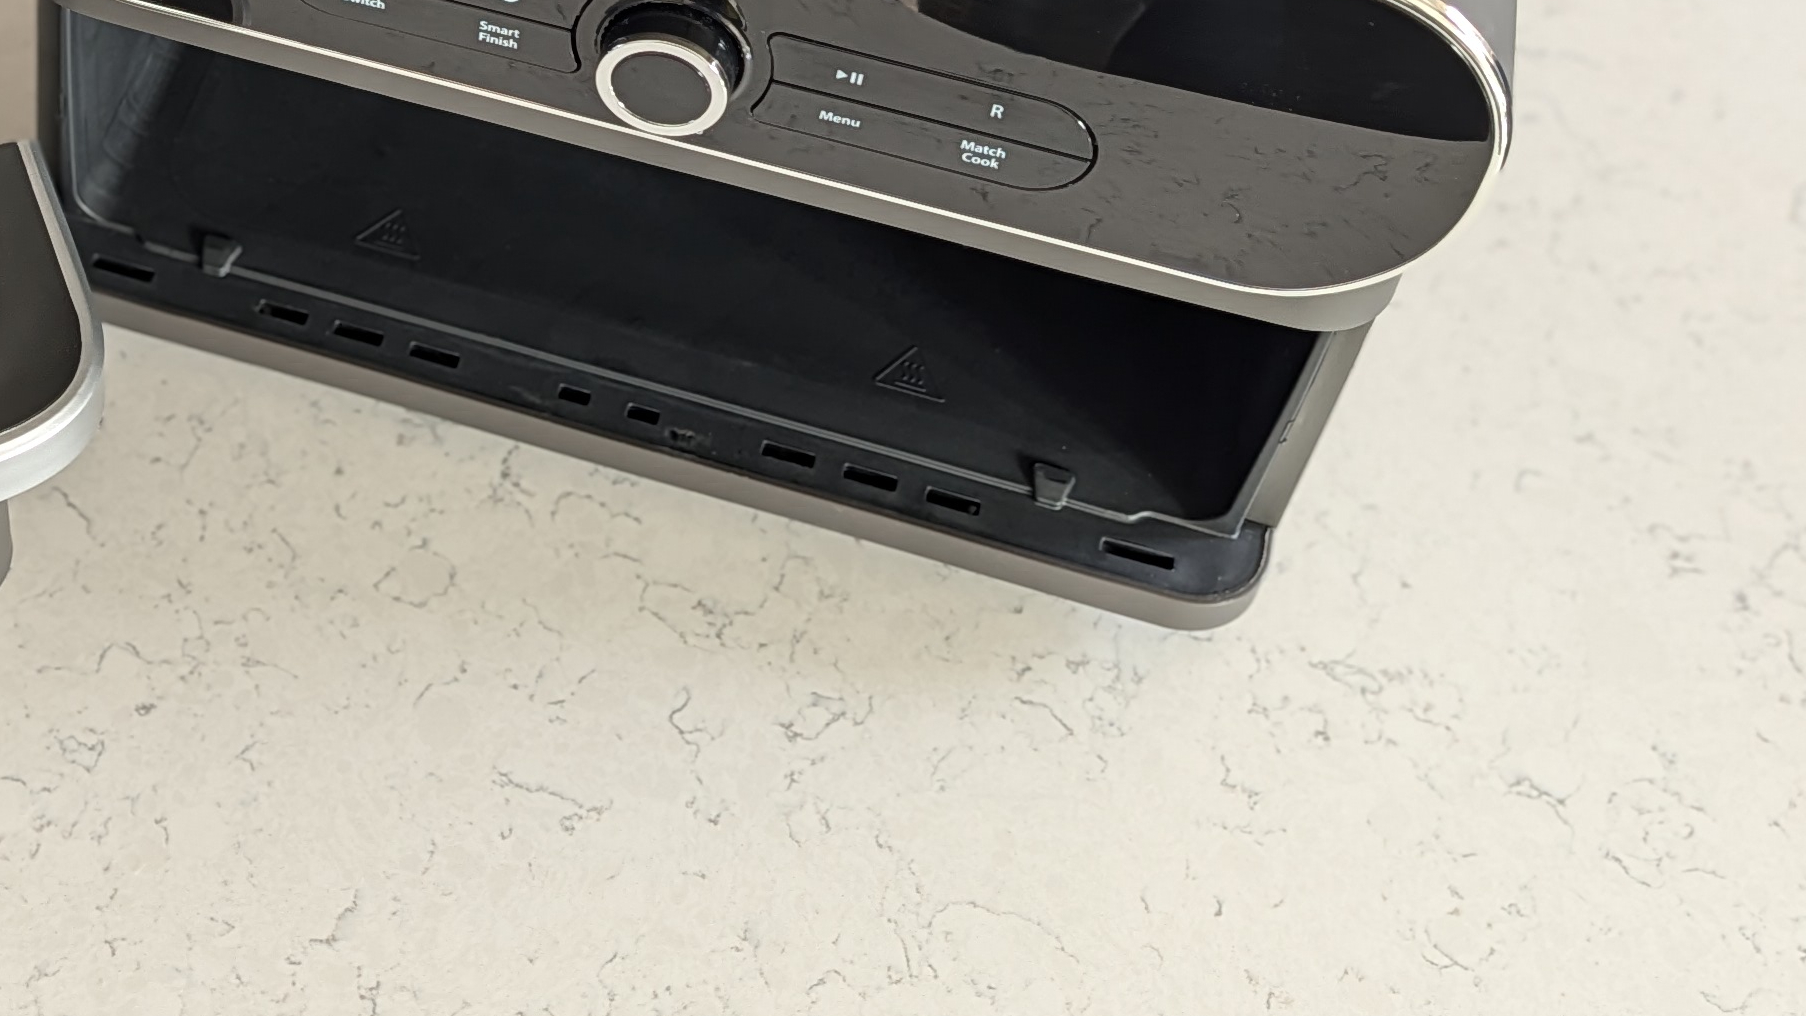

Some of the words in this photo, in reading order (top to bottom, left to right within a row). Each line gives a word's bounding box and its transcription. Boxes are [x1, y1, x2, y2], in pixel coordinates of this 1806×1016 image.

[479, 20, 520, 39] Smart
[478, 31, 518, 50] Finish
[818, 110, 861, 128] Menu
[989, 103, 1005, 119] R
[960, 139, 1006, 159] Match
[961, 152, 999, 170] Cook
